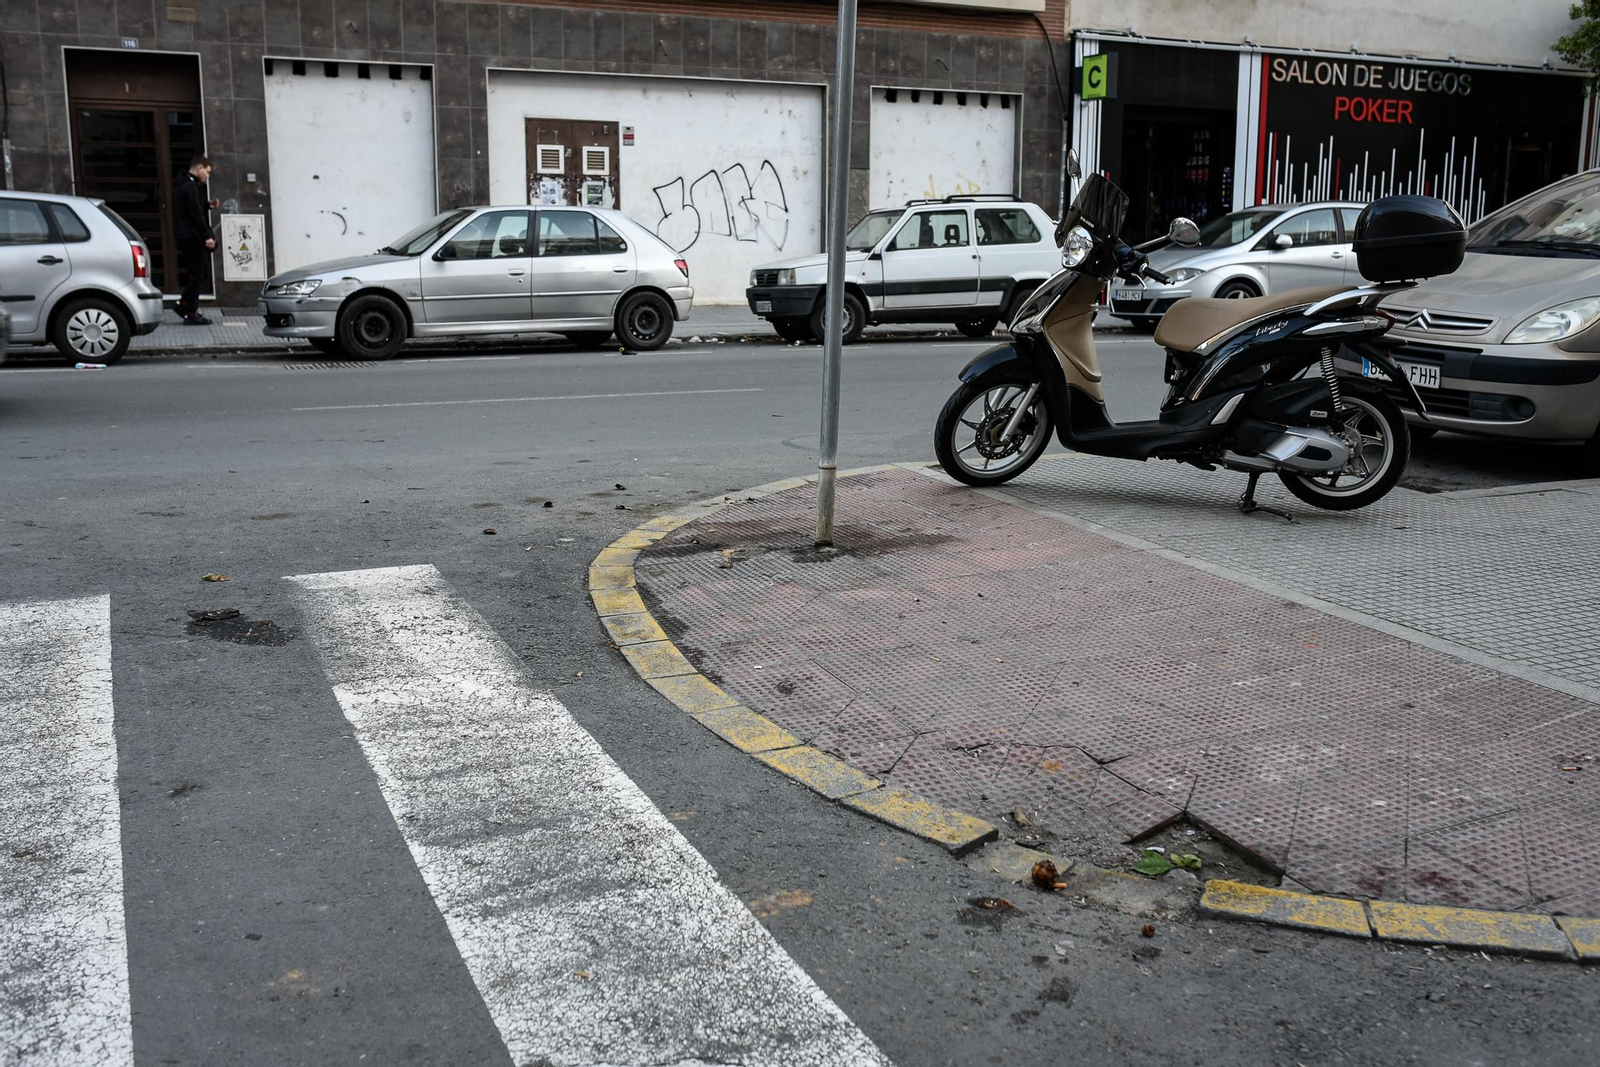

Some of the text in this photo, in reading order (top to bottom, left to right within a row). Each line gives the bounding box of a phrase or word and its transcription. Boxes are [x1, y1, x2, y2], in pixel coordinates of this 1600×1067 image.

[1088, 65, 1102, 89] C
[1271, 58, 1472, 96] SALON DE JUEGOS
[1333, 96, 1413, 124] POKER
[1255, 320, 1289, 337] Liberty
[1410, 366, 1438, 386] FHH
